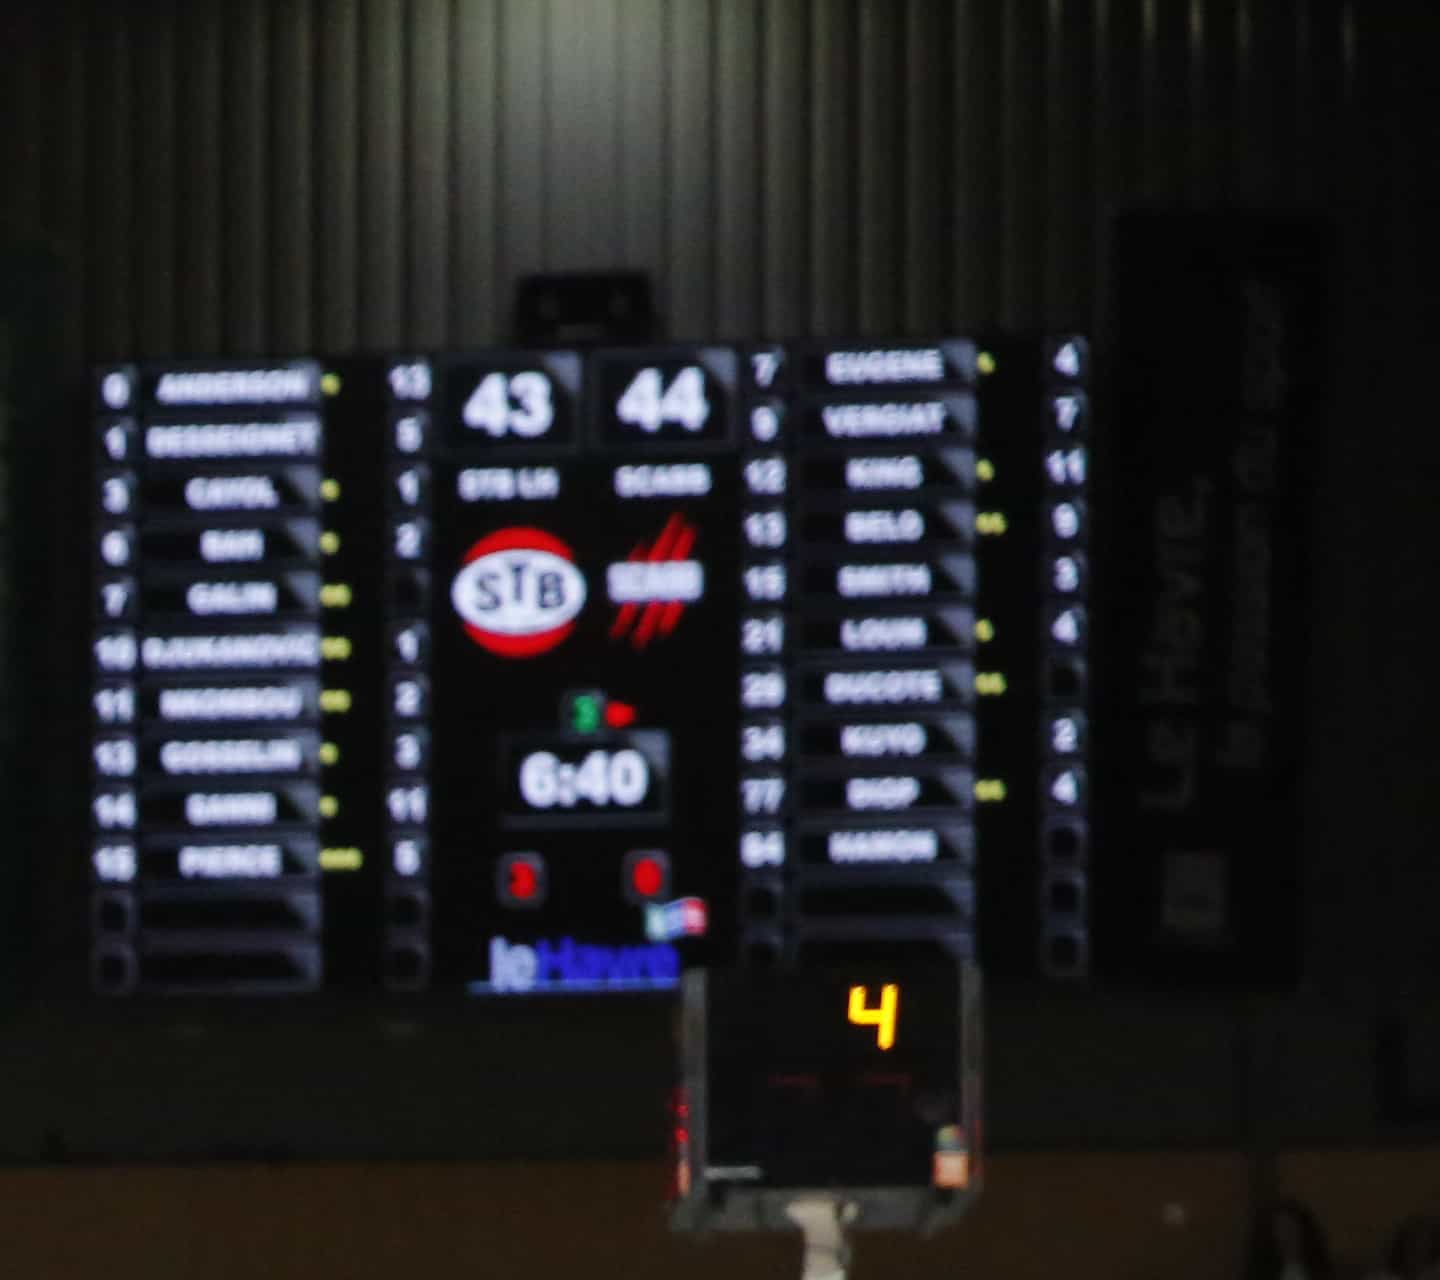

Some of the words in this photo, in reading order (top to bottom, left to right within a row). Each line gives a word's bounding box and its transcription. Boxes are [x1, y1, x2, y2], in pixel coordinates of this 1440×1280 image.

[463, 371, 553, 437] 43
[617, 366, 709, 432] 44
[476, 563, 566, 611] STB
[94, 687, 134, 721] 11
[520, 749, 648, 808] 6:40
[847, 983, 899, 1051] 4
